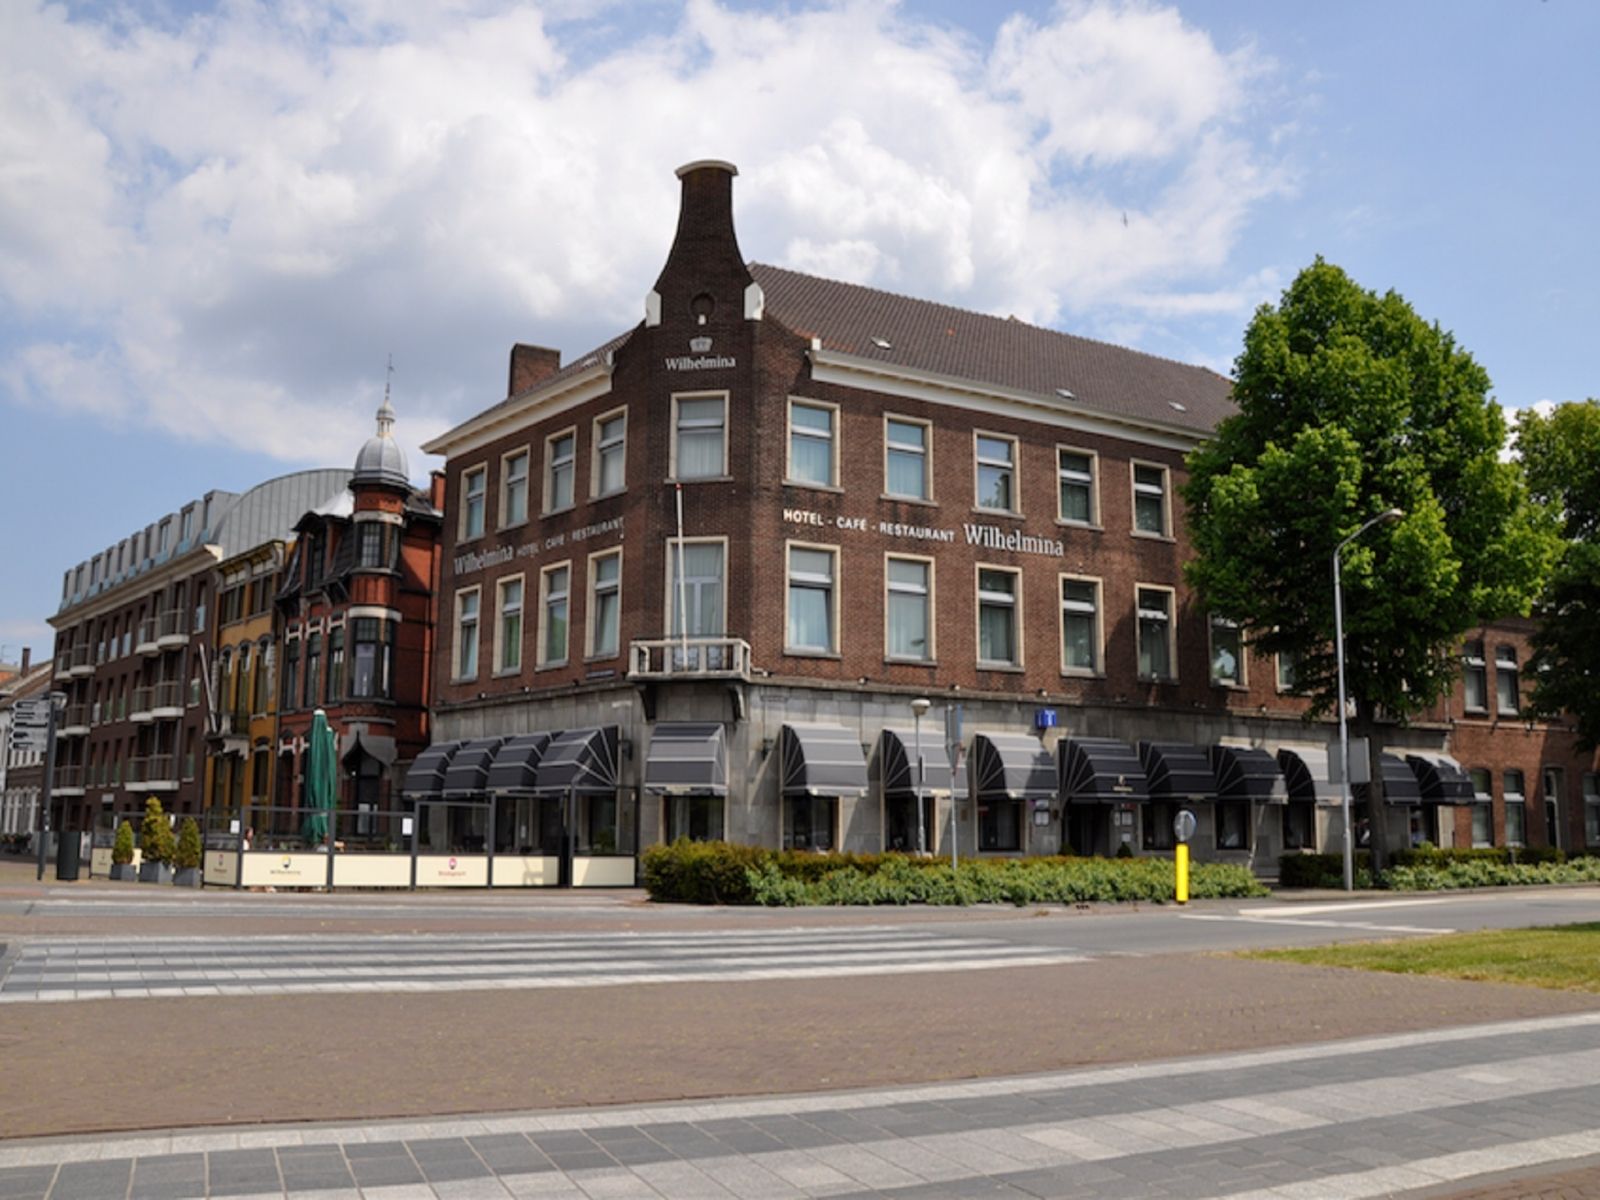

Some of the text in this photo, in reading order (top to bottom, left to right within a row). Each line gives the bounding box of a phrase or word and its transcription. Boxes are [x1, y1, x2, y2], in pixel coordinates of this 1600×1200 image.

[664, 354, 737, 371] Wilhelmina
[453, 545, 514, 575] Wilhelmina
[571, 516, 624, 541] RESTAURANT
[783, 508, 1064, 556] HOTEL CAFÉ RESTAURANT Wilhelmina
